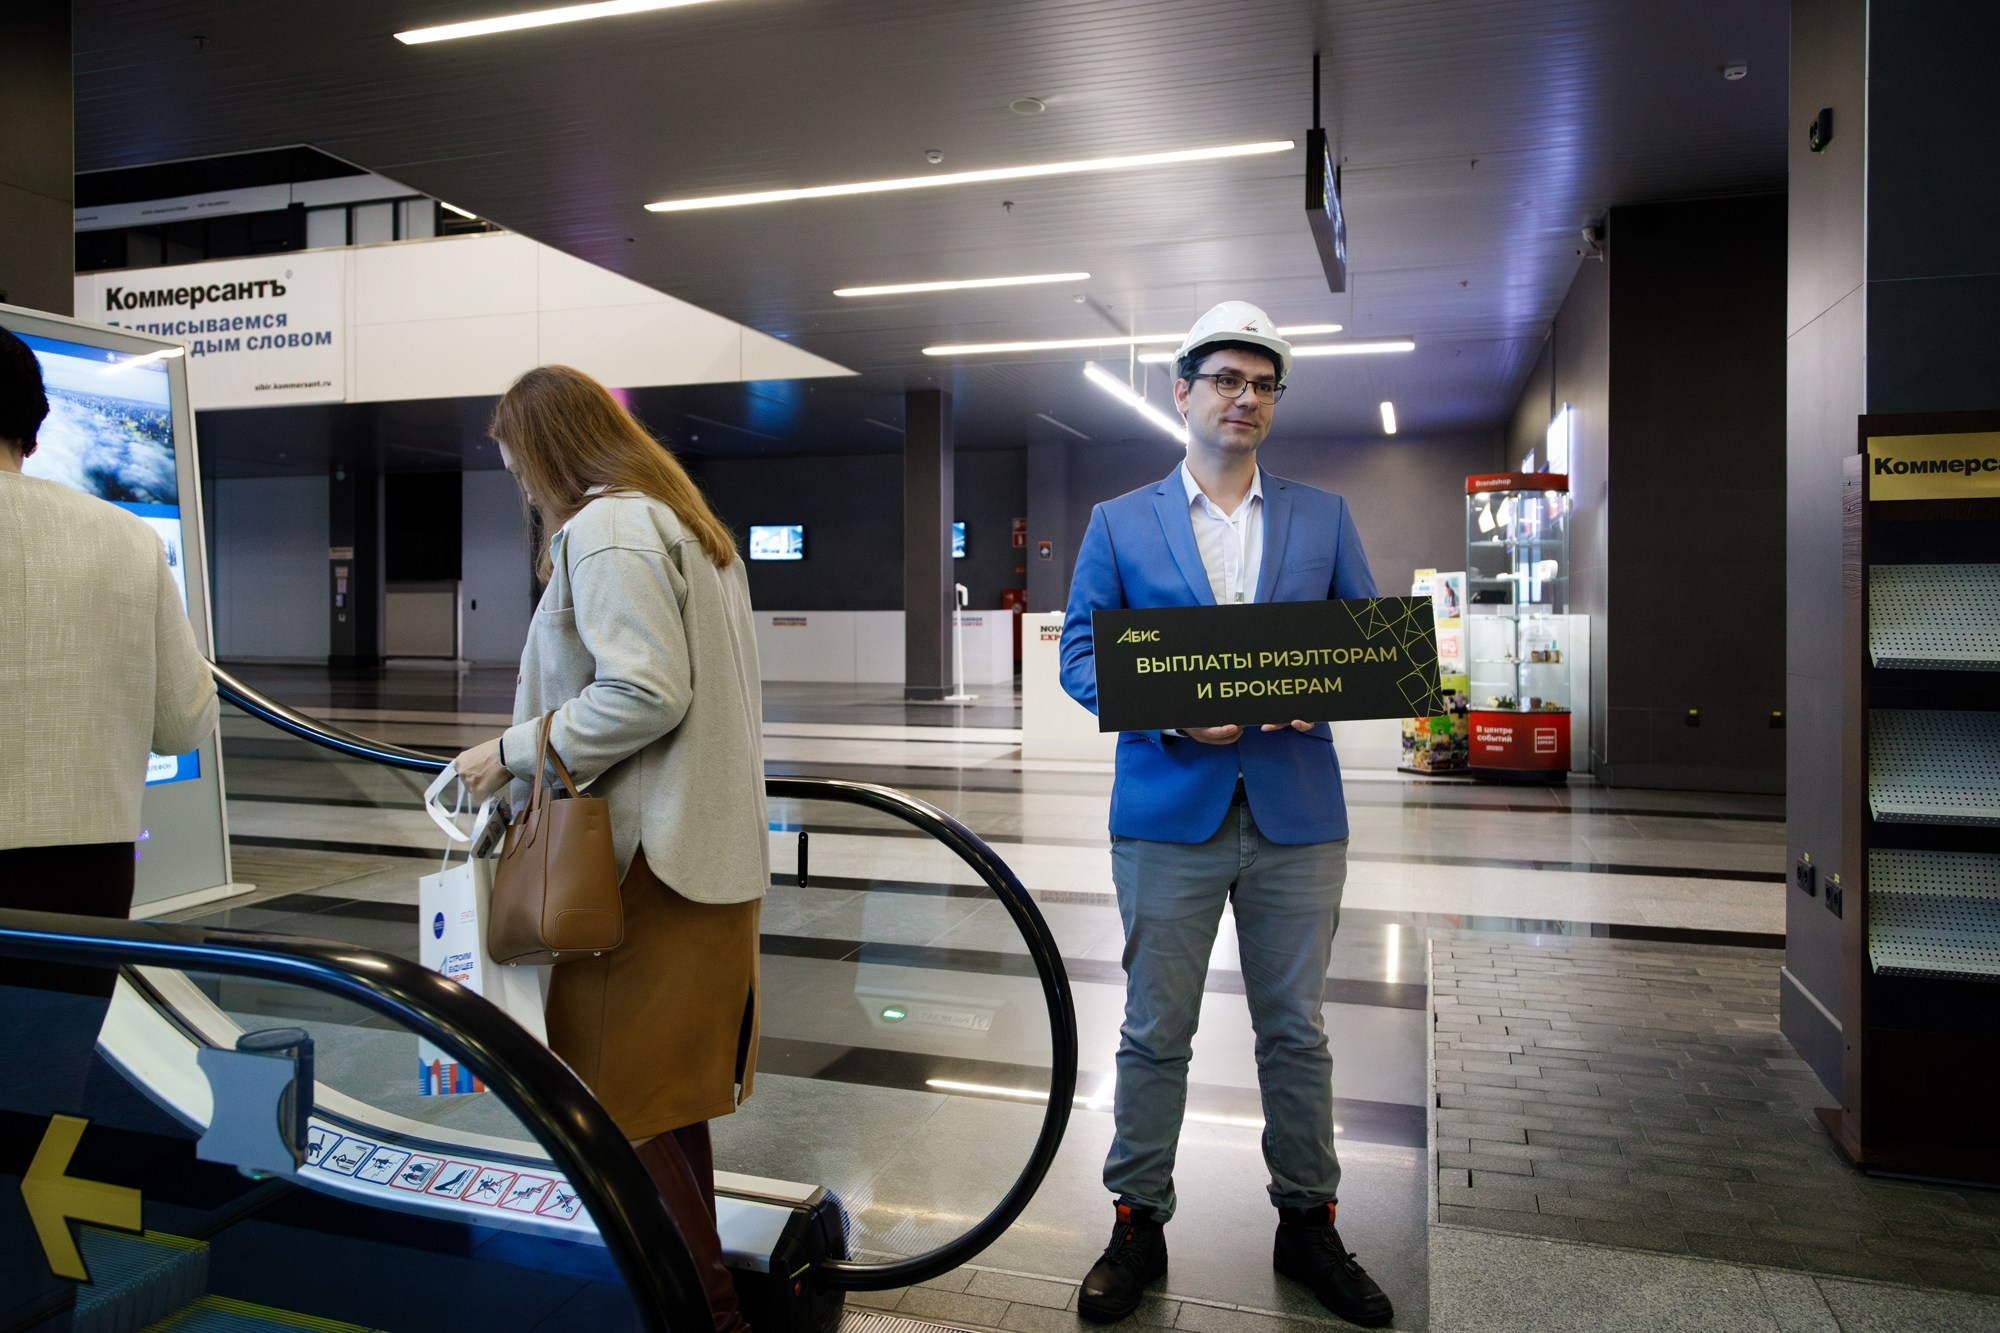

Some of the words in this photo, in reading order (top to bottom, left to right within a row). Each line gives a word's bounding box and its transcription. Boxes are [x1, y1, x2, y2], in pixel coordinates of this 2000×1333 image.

[106, 279, 286, 311] Коммерсантъ
[107, 313, 288, 336] дписываемся
[189, 336, 240, 358] дым
[246, 331, 332, 350] словом
[1874, 457, 2000, 477] Коммерс
[1040, 625, 1064, 633] NOV
[1040, 633, 1060, 641] EXP
[1136, 653, 1252, 674] ВЫПЛАТЫ
[1259, 646, 1398, 668] РИЭЛТОРАМ
[1197, 683, 1213, 699] И
[1219, 676, 1343, 699] БРОКЕРАМ
[1476, 725, 1482, 733] В
[1484, 726, 1513, 735] центре
[1477, 733, 1513, 743] событий
